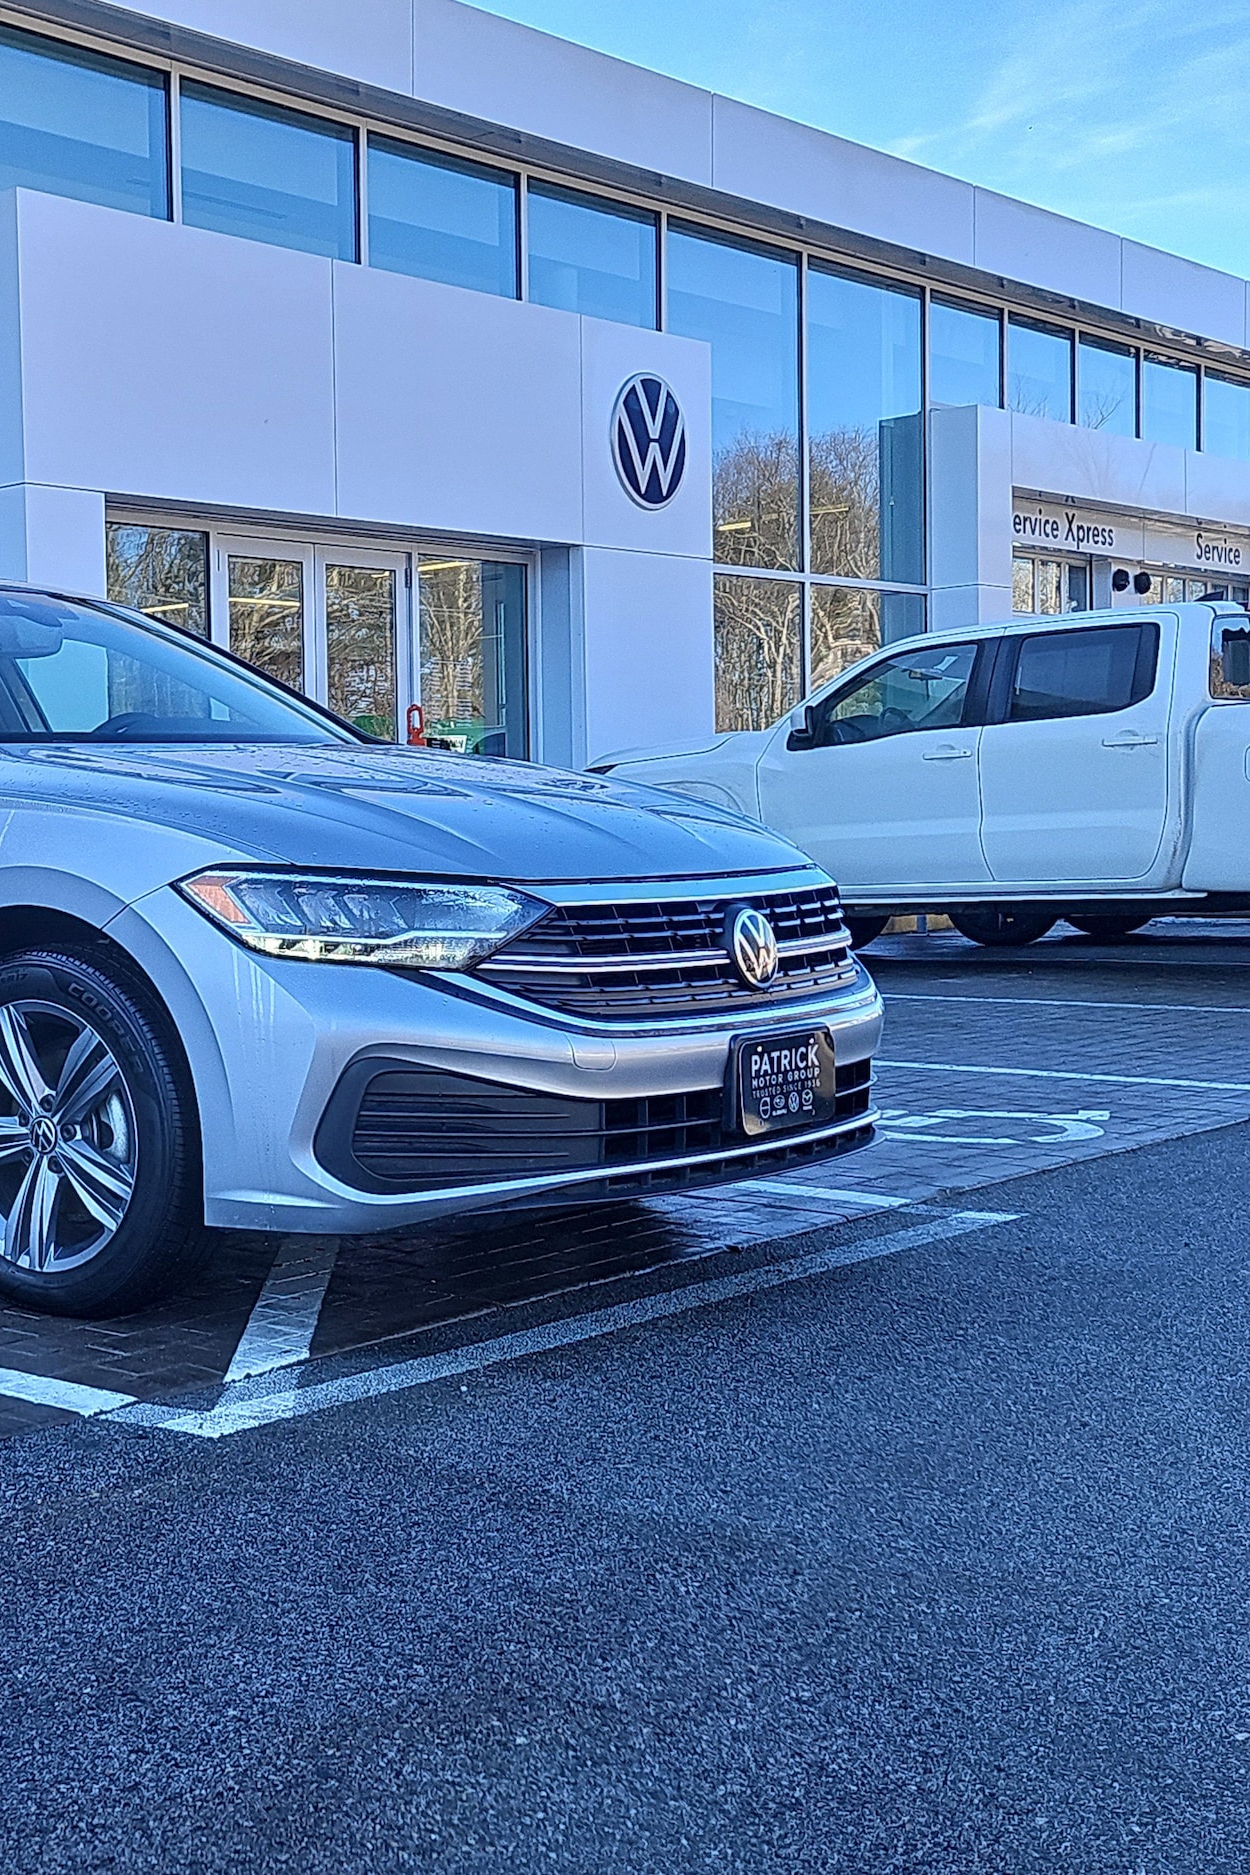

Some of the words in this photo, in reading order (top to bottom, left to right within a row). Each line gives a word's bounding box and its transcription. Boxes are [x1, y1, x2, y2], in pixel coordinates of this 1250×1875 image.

[1013, 508, 1059, 539] ervice
[1065, 511, 1114, 549] Xpress
[1196, 533, 1241, 565] Service
[66, 981, 145, 1074] COOPER
[751, 1044, 820, 1077] PATRICK
[752, 1074, 783, 1089] MOTOR
[787, 1067, 820, 1081] GROUP
[752, 1086, 781, 1099] TRUSTED
[783, 1081, 802, 1093] SINCE
[804, 1079, 821, 1088] 1936
